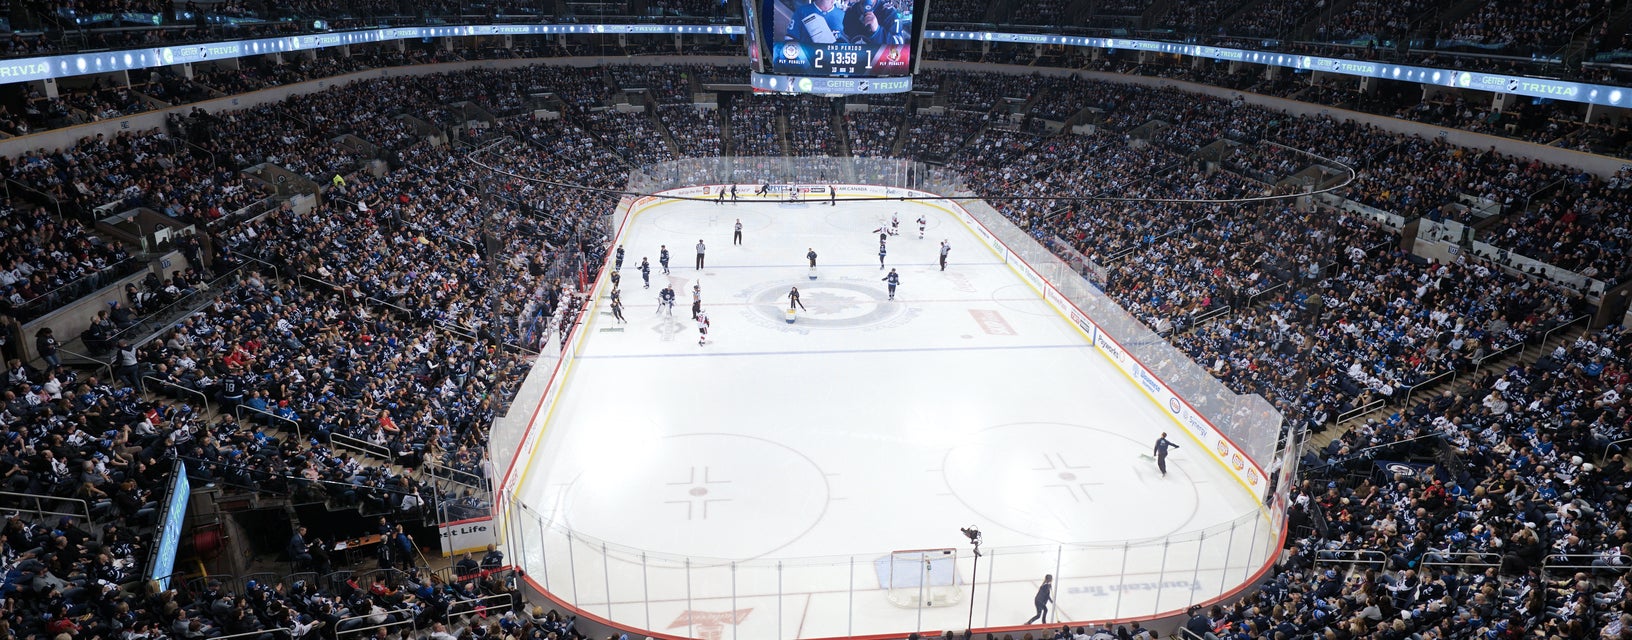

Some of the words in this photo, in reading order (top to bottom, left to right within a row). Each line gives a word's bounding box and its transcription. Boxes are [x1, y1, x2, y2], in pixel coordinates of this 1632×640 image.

[208, 46, 238, 55] TRIVIA
[815, 49, 824, 68] 2
[830, 52, 857, 65] 13:59
[865, 50, 873, 69] 1
[0, 63, 46, 77] RIVIA
[1341, 63, 1372, 73] TRIVIA
[827, 80, 855, 88] GETTER
[873, 81, 909, 90] TRIVIA
[1482, 76, 1506, 86] GETTER
[1522, 82, 1573, 95] TRIVIA
[225, 382, 235, 392] 18
[461, 526, 487, 535] Life
[1068, 585, 1108, 597] Tire
[1109, 579, 1203, 593] Fountain
